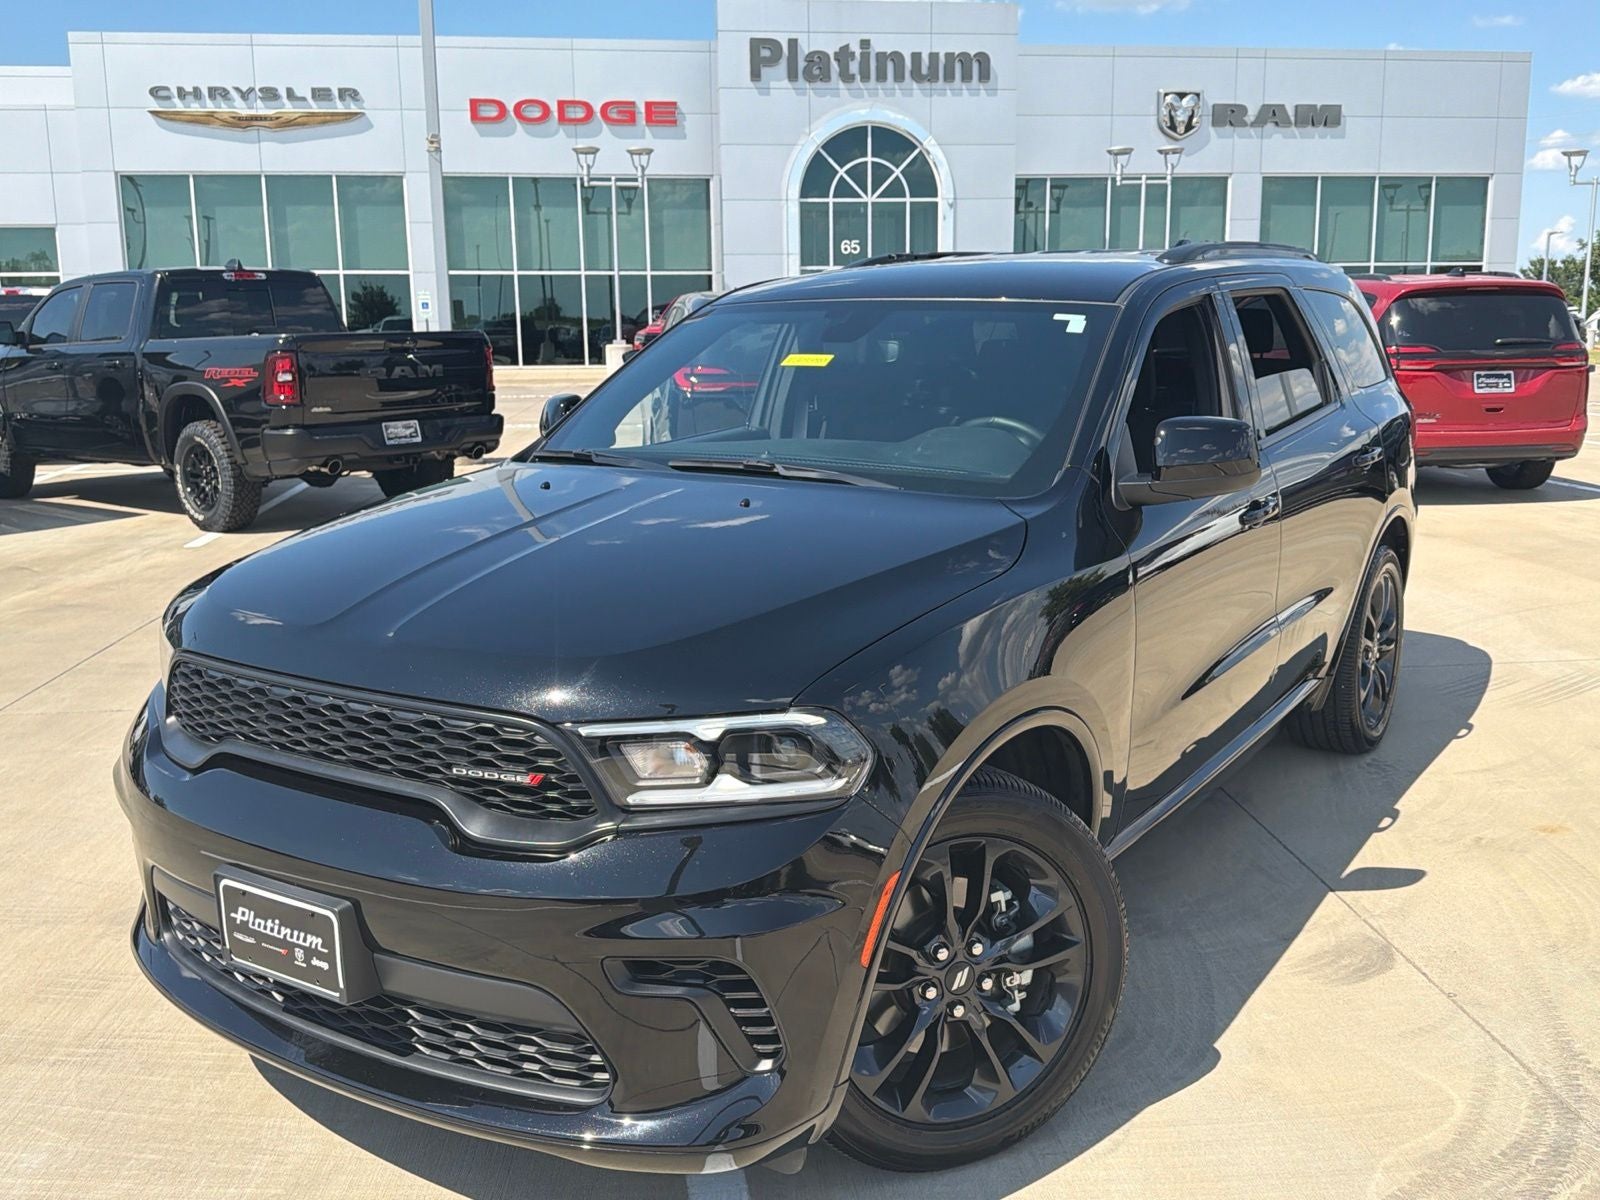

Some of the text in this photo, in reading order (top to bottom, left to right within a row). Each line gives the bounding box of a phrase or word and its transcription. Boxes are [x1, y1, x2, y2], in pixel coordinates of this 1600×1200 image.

[749, 37, 991, 84] Platinum
[149, 85, 361, 102] CHRYSLER
[469, 98, 678, 126] DODGE
[1211, 103, 1342, 128] RAM
[840, 239, 860, 255] 65
[359, 364, 444, 379] RAM
[452, 767, 533, 784] DODGE
[230, 906, 329, 953] Platinum
[311, 956, 329, 971] Jeep
